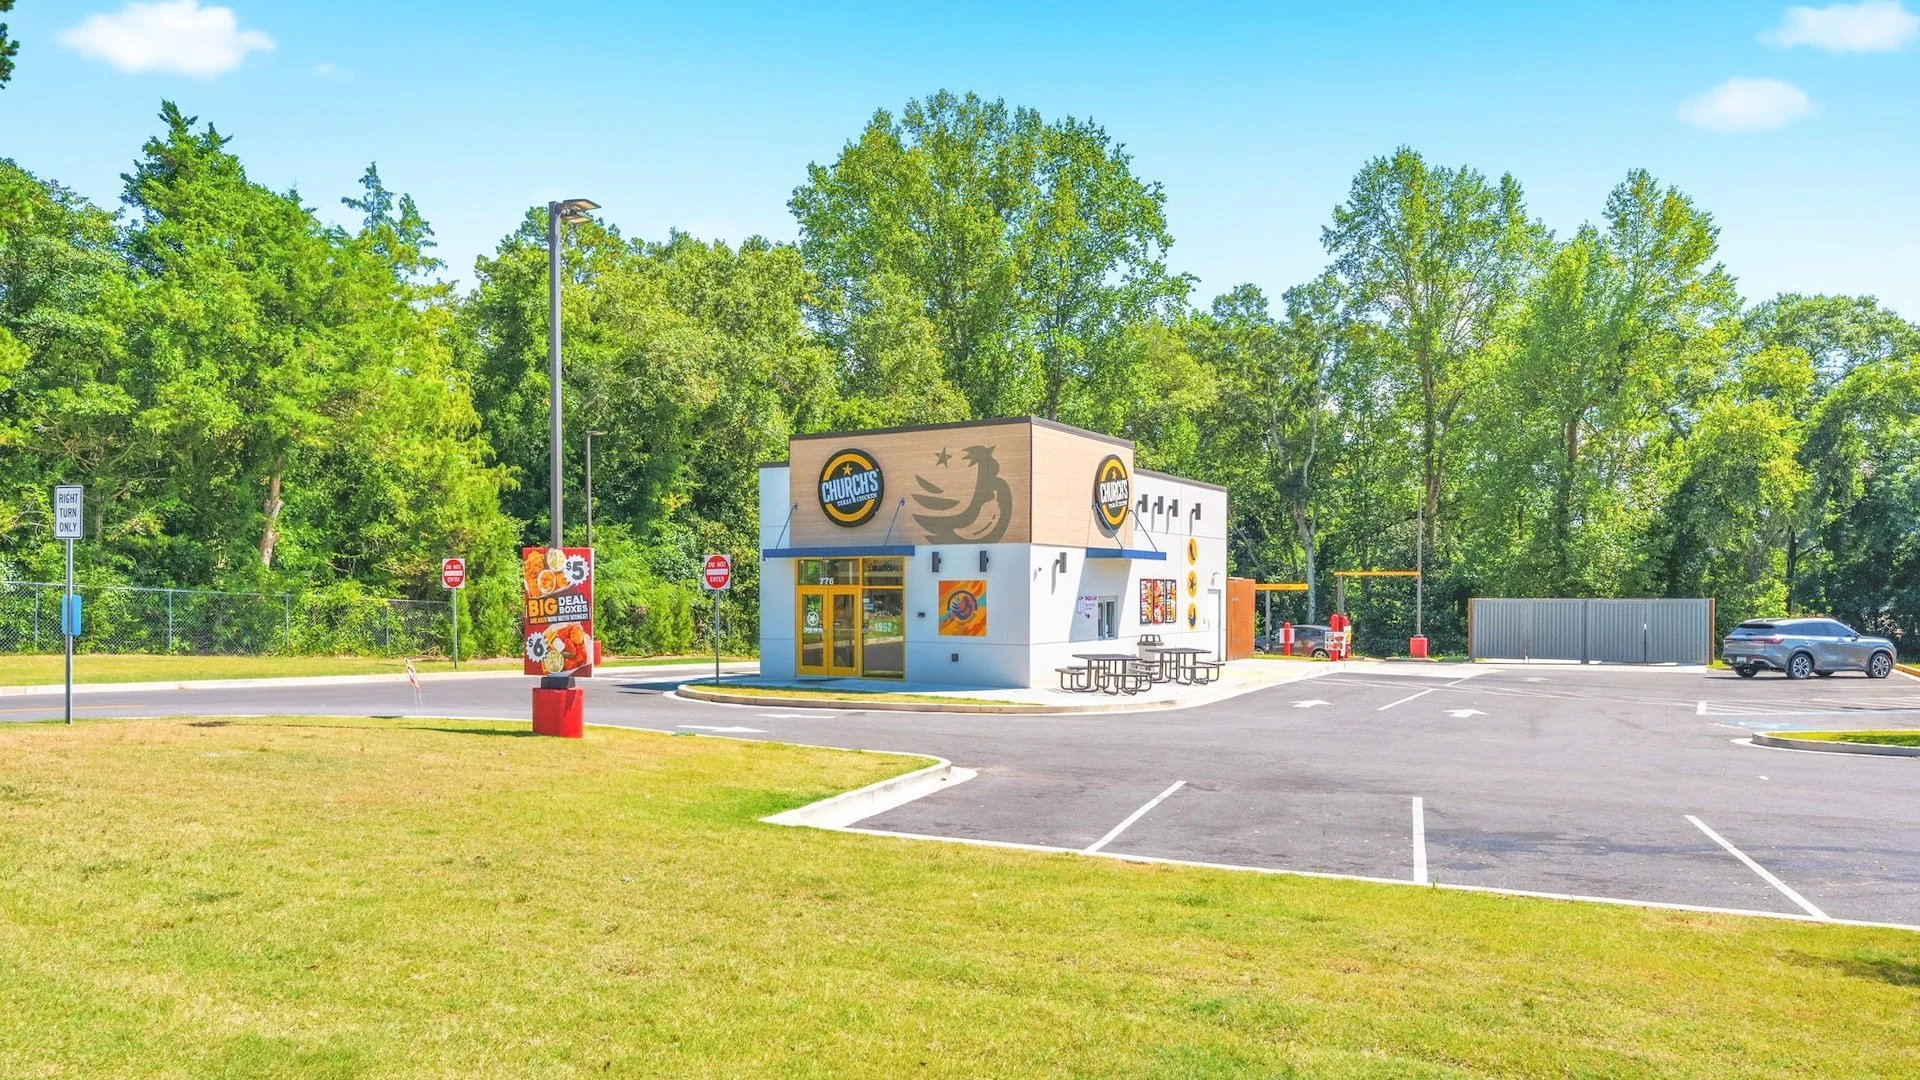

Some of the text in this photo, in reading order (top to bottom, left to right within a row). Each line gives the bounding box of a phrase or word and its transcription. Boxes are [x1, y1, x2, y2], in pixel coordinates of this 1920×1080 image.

[821, 469, 879, 503] CHURCH'S
[59, 493, 78, 504] RIGHT
[59, 507, 77, 518] TURN
[59, 522, 77, 533] ONLY
[565, 561, 585, 580] $5
[819, 577, 835, 585] 776
[528, 594, 588, 617] BIG DEAL
[558, 604, 589, 614] BOXES
[874, 622, 893, 633] 1952
[528, 638, 545, 657] $6
